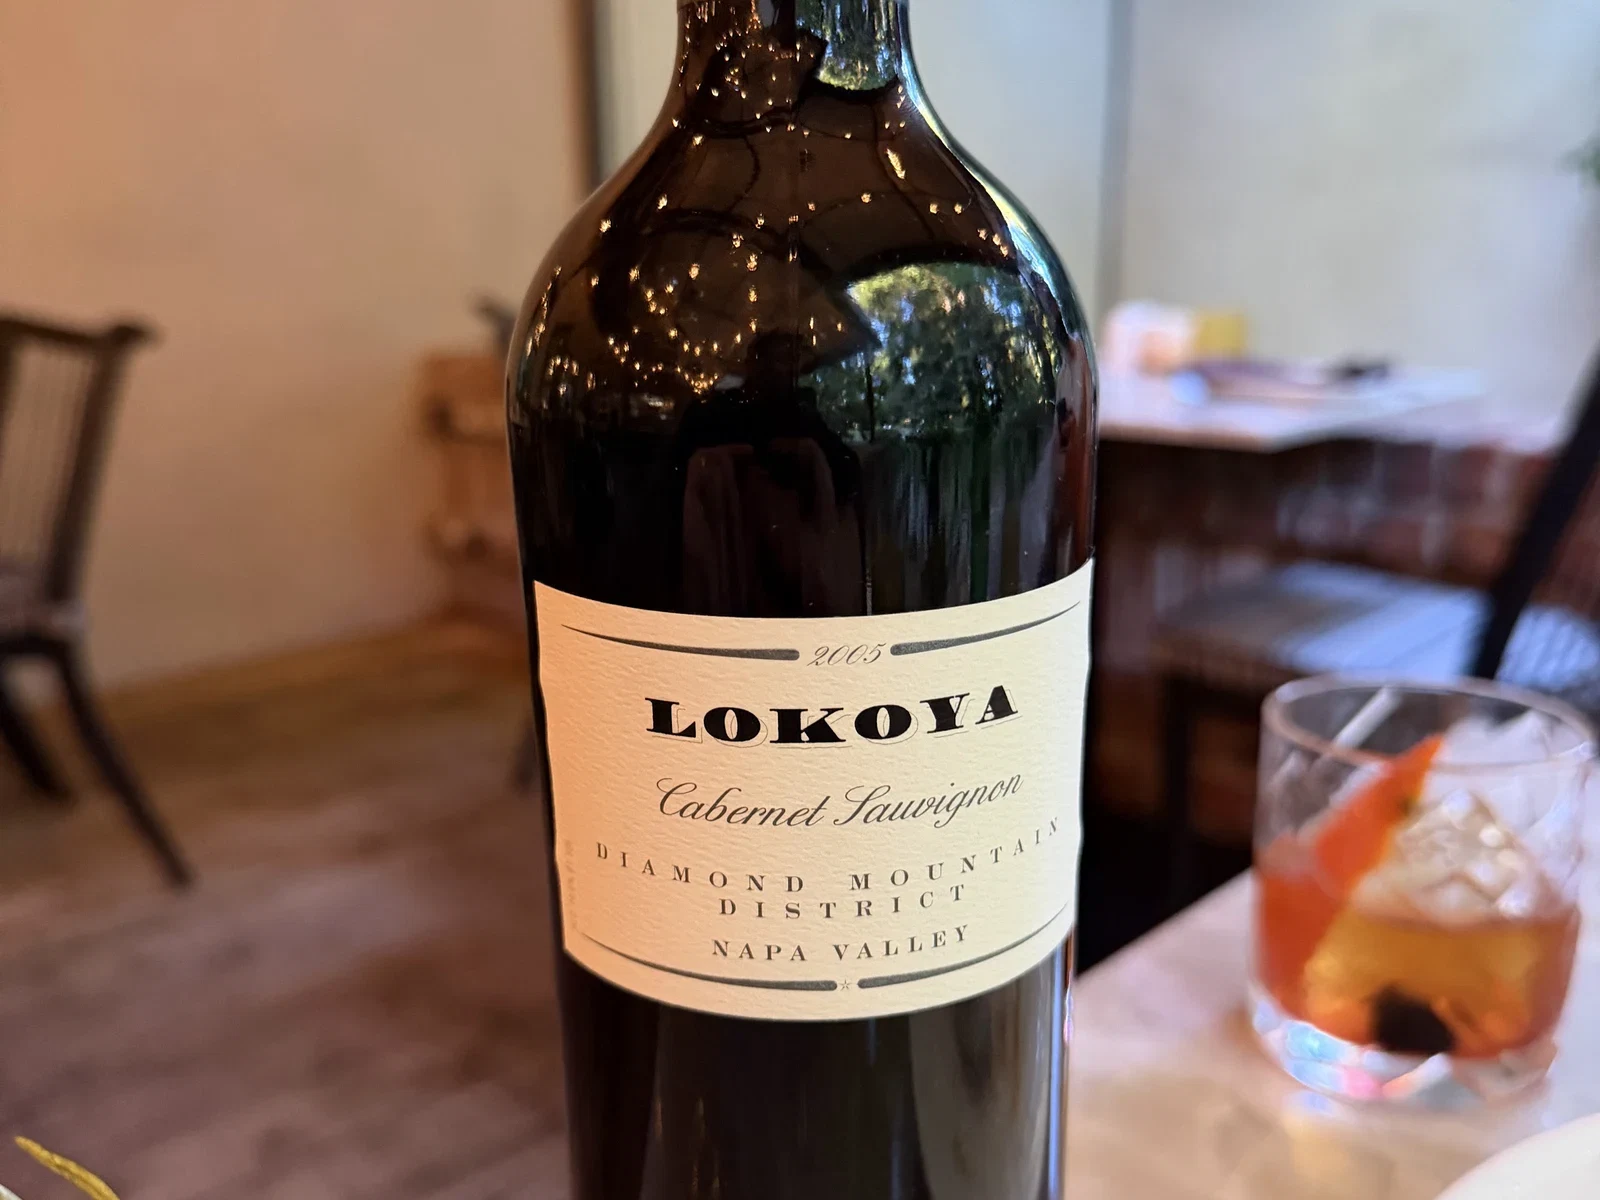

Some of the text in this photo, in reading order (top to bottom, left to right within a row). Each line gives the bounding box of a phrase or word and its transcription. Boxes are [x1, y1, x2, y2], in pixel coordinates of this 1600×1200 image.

[807, 643, 887, 667] 2005
[644, 684, 1021, 748] LOKOYA
[656, 773, 1025, 829] Cabernet Sauvignon
[596, 842, 804, 893] DIAMOND
[850, 817, 1059, 891] MOUNTAIN
[719, 884, 965, 919] DISTRICT
[711, 924, 968, 961] NAPA VALLEY
